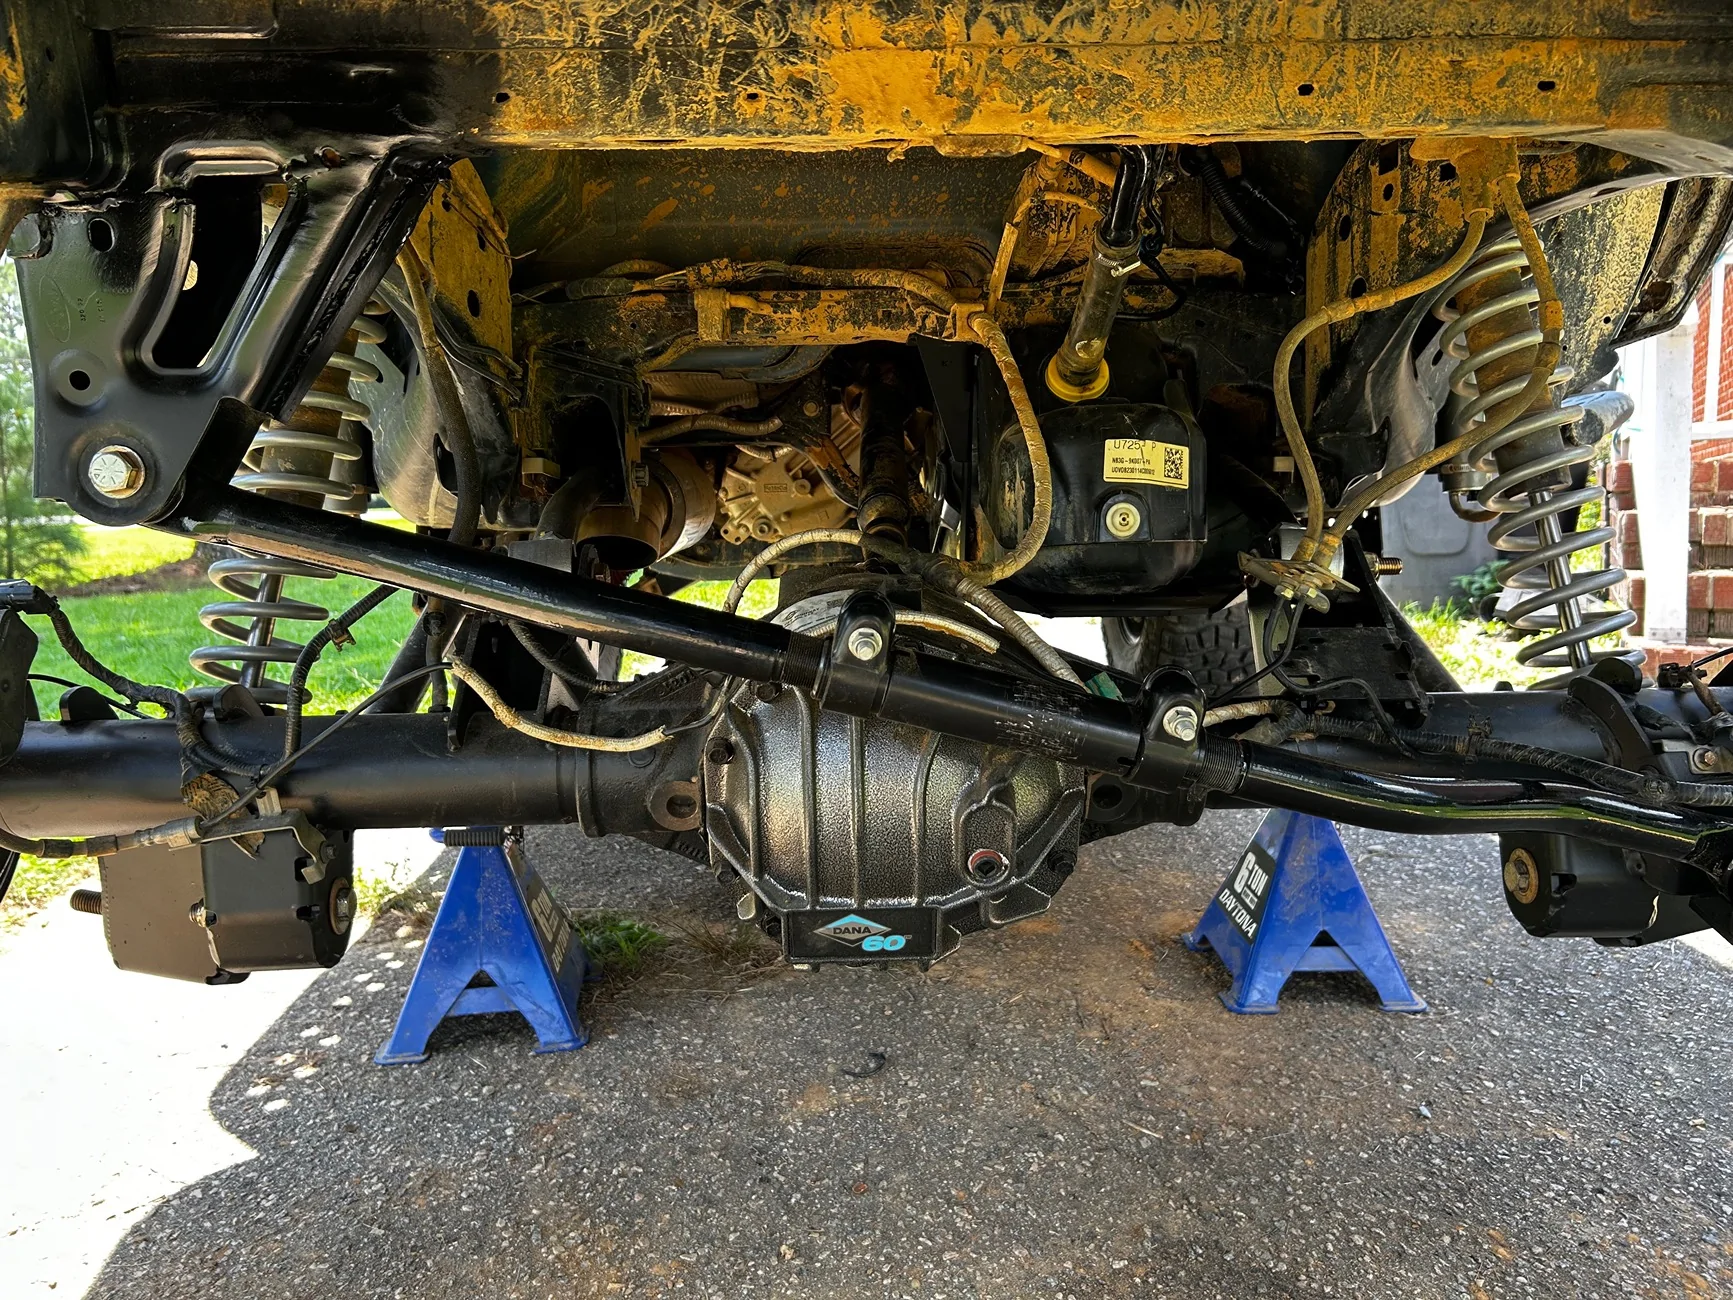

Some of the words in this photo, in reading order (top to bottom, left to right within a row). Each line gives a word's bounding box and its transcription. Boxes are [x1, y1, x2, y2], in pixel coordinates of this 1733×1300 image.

[1234, 851, 1256, 893] 6
[1247, 864, 1269, 896] TON
[1218, 888, 1258, 939] DAYTONA
[832, 926, 872, 935] DANA
[861, 935, 906, 952] 60
